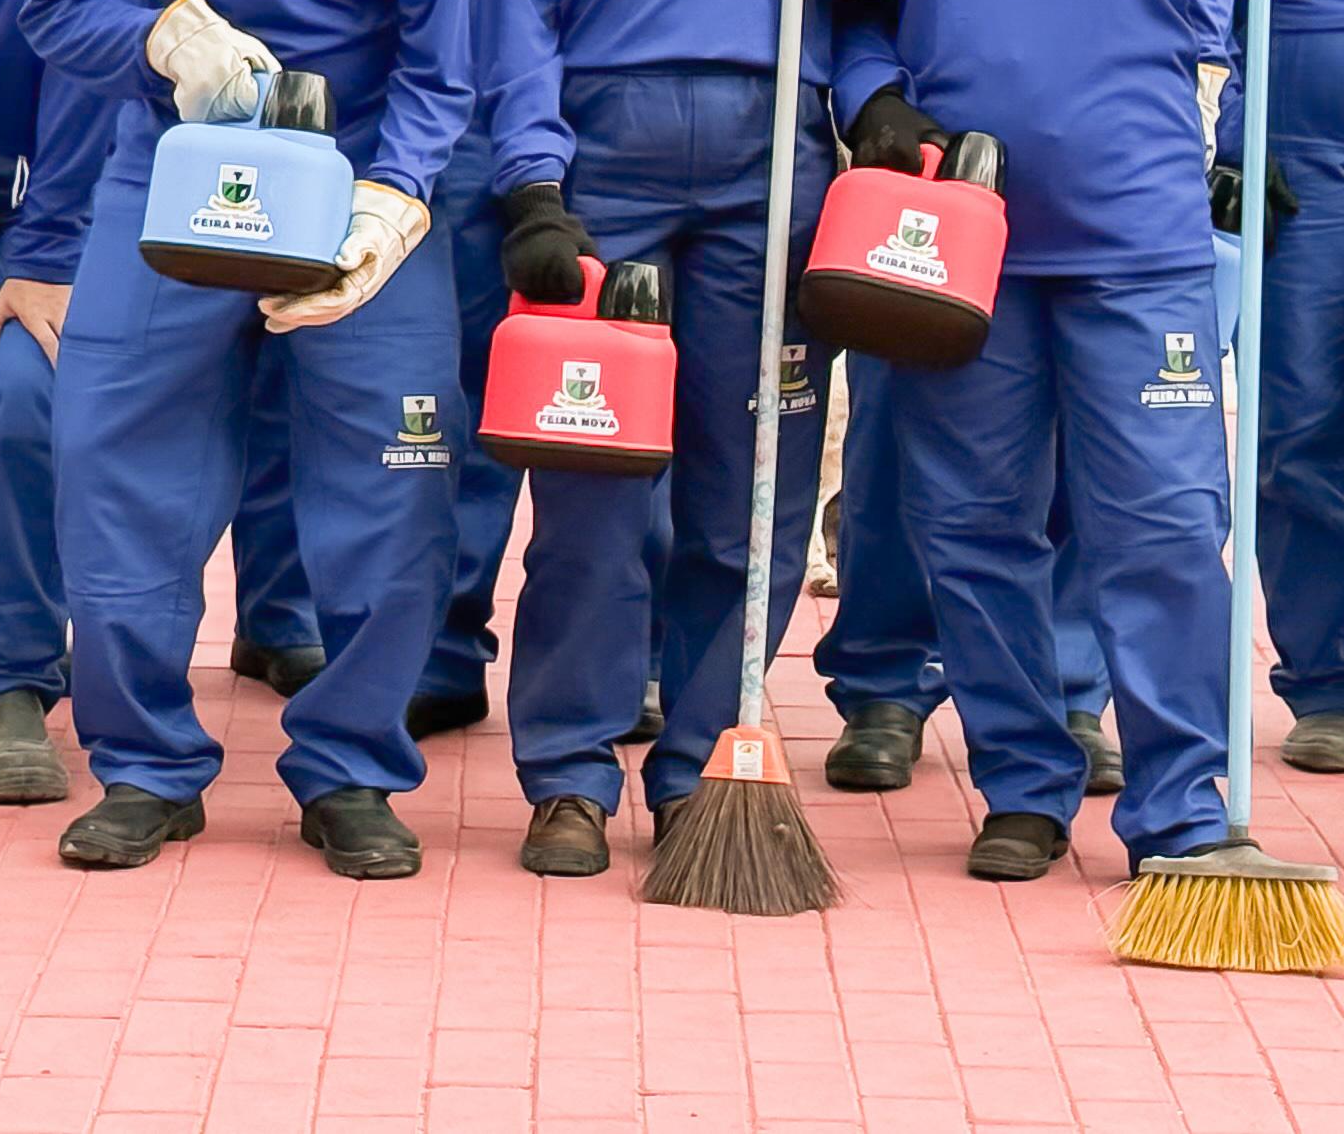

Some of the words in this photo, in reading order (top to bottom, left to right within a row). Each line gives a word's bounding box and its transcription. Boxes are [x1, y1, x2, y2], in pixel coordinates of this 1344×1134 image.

[193, 217, 231, 229] FEIRA
[235, 221, 270, 233] NOVA
[870, 254, 907, 269] FEIRA
[910, 265, 945, 280] NOVA
[1141, 390, 1187, 404] FEIRA
[539, 415, 577, 426] FEIRA
[581, 418, 616, 428] NOVA
[382, 451, 425, 465] FEIRA
